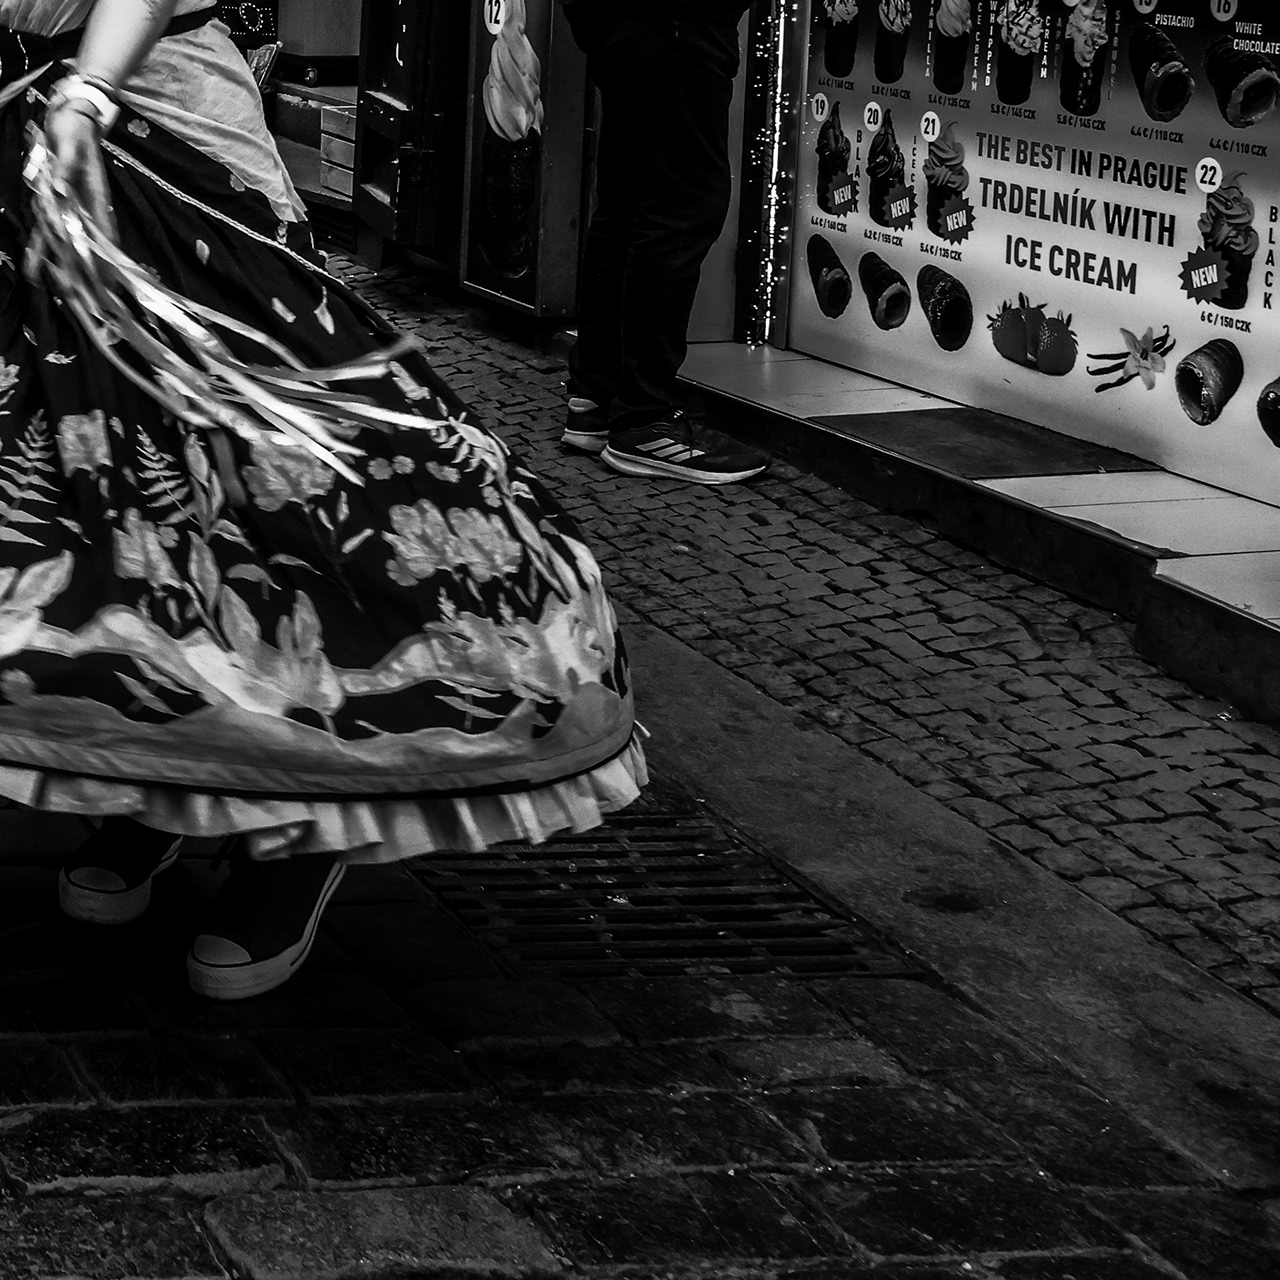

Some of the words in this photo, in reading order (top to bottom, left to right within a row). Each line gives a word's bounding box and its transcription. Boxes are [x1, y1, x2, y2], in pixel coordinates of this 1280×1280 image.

[488, 0, 501, 25] 12
[1155, 13, 1195, 29] PISTACHIO
[1235, 21, 1263, 36] WHITE
[985, 0, 998, 87] WHIPPED
[1040, 15, 1052, 79] CREAM
[1233, 39, 1280, 55] CHOCOLATE
[970, 31, 982, 92] CREAM
[814, 98, 825, 116] 19
[867, 108, 879, 125] 20
[1024, 109, 1036, 120] CZK
[924, 117, 936, 135] 21
[1092, 120, 1106, 131] CZK
[1155, 129, 1168, 141] 110
[1169, 131, 1184, 144] CZK
[1236, 142, 1250, 154] 110
[1251, 145, 1268, 158] CZK
[852, 130, 862, 213] BLAK
[976, 131, 1011, 162] THE
[1015, 139, 1066, 171] BEST
[1070, 148, 1093, 177] IN
[1098, 152, 1188, 195] PRAGUE
[1200, 164, 1217, 186] 22
[833, 184, 852, 206] NEW
[890, 197, 911, 219] NEW
[979, 177, 1097, 231] TRDELNÍK
[1103, 201, 1176, 248] WITH
[946, 209, 967, 232] NEW
[950, 249, 962, 261] CZK
[1005, 234, 1042, 272] ICE
[1048, 245, 1138, 295] CREAM
[1263, 206, 1278, 309] BLACK
[1190, 263, 1218, 289] NEW
[1220, 315, 1234, 328] 150
[1235, 319, 1251, 333] CZK
